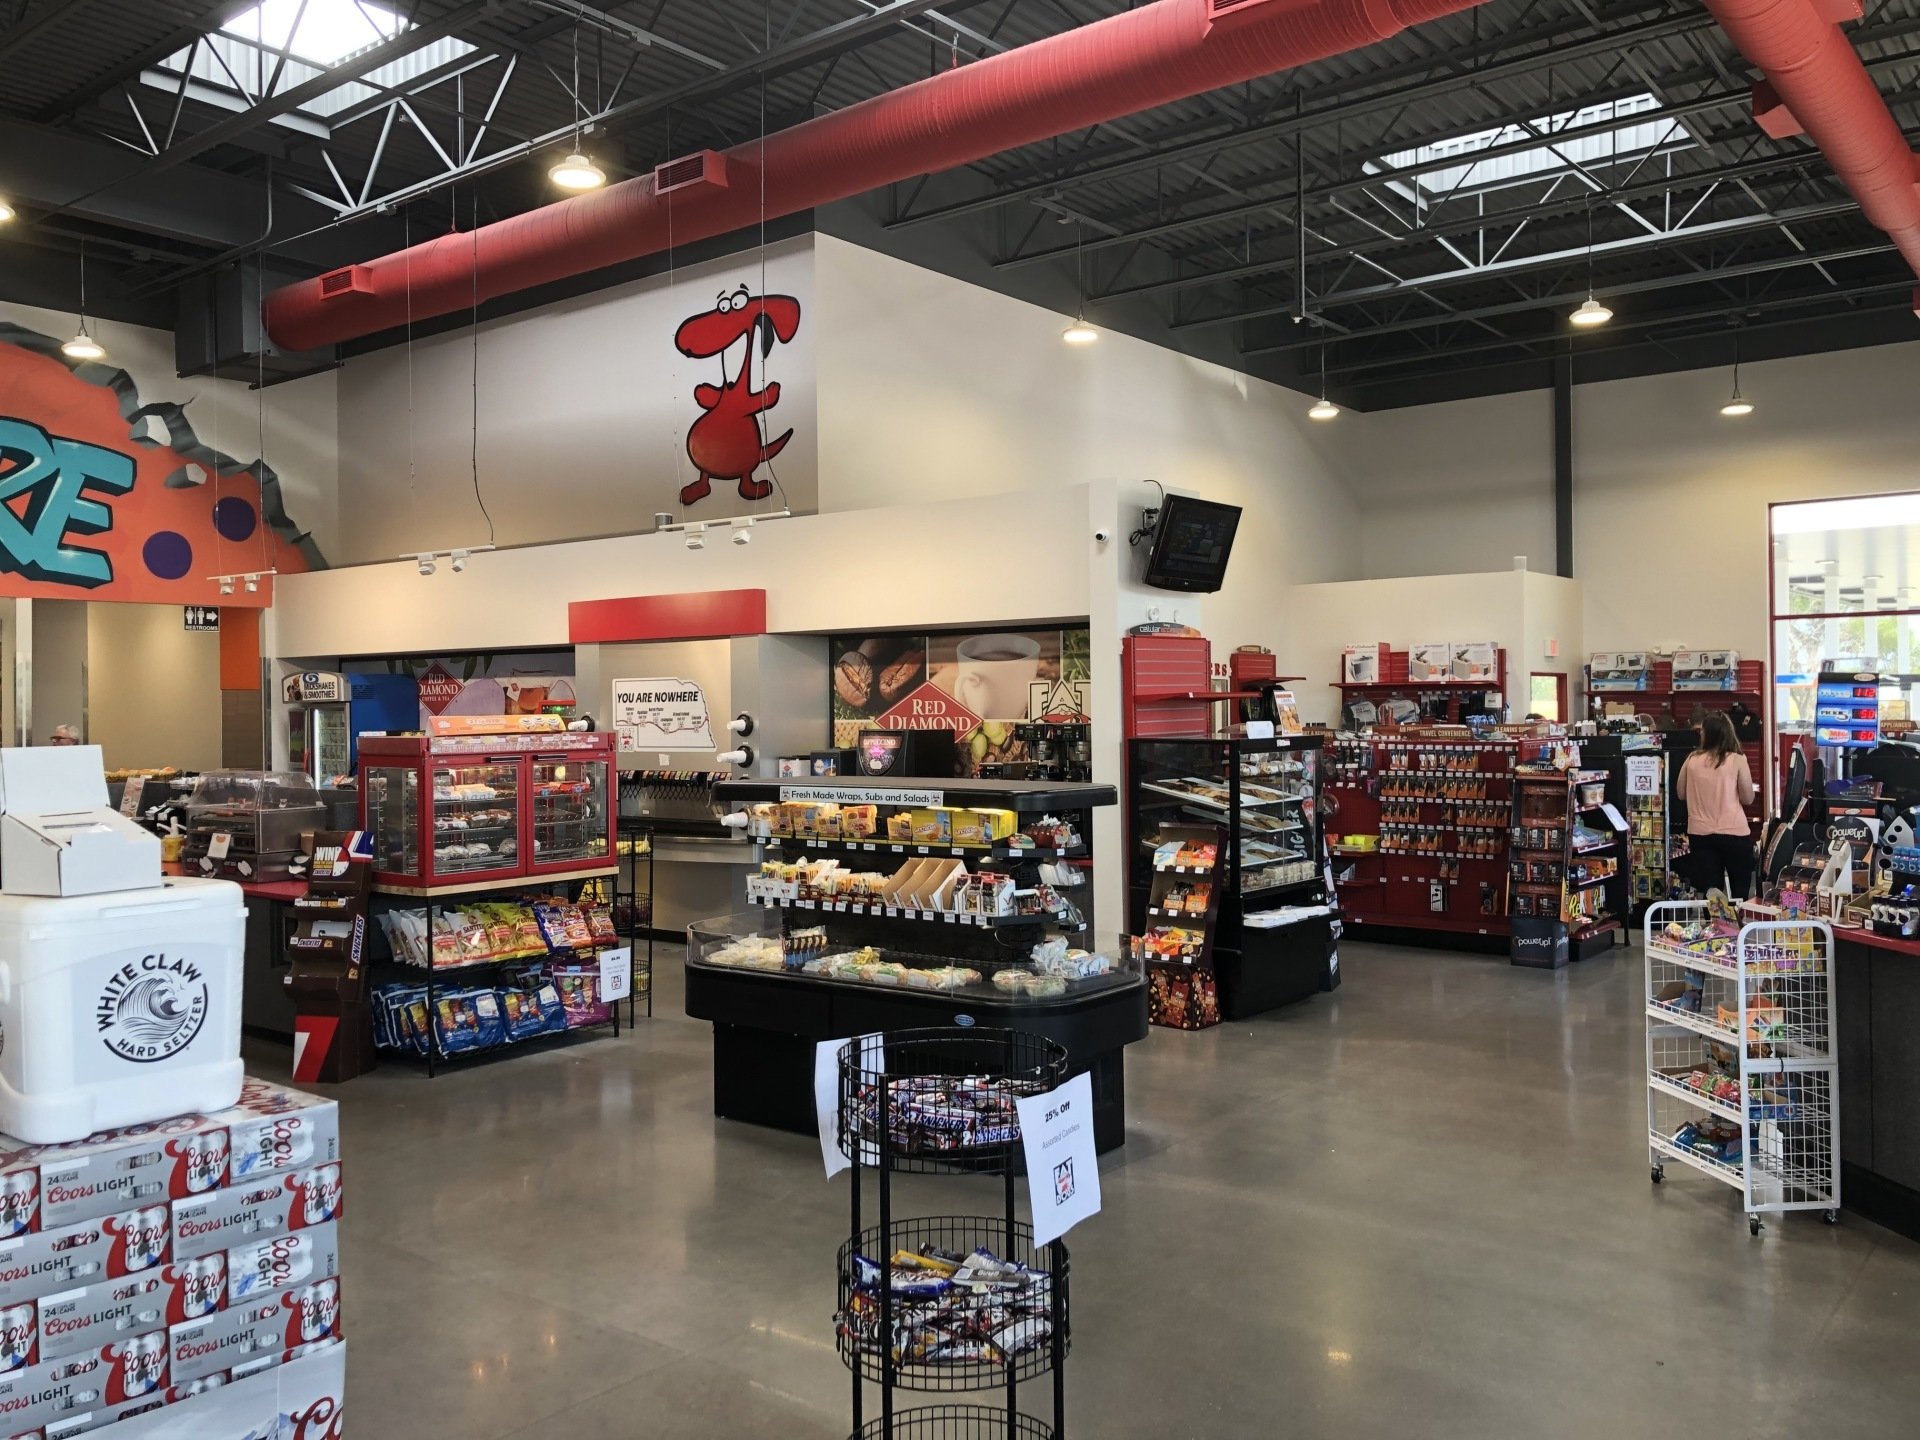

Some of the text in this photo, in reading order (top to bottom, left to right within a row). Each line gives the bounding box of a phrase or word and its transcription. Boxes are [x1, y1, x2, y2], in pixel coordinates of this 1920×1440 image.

[1140, 625, 1160, 633] cellular
[304, 681, 335, 690] MILKSHAKES
[428, 673, 445, 685] RED
[617, 691, 699, 703] YOU ARE NOWHERE
[912, 699, 946, 715] RED
[889, 715, 971, 731] DIAMOND
[1439, 730, 1471, 738] CONVENIENCE
[791, 790, 810, 799] Fresh
[813, 791, 834, 800] Made
[836, 792, 862, 802] Wraps,
[865, 793, 883, 801] Subs
[885, 793, 900, 802] and
[903, 794, 930, 803] Salads
[352, 918, 365, 962] SNICKERS
[97, 953, 202, 1033] WHITE CLAW
[116, 996, 203, 1057] HARD SELTZER
[918, 1115, 969, 1131] SNICKERS
[1044, 1101, 1070, 1123] 25% Off
[974, 1126, 1020, 1142] SNICKERS
[1042, 1123, 1080, 1150] Assorted Candies
[259, 1125, 272, 1168] LIGHT
[47, 1176, 60, 1185] 24
[47, 1175, 135, 1204] Coors LIGHT
[0, 1190, 32, 1212] oors
[178, 1211, 190, 1220] 24
[179, 1209, 258, 1239] Coors LIGHT
[0, 1255, 72, 1282] oors LIGHT
[257, 1245, 271, 1288] LIGHT
[44, 1308, 57, 1318] 24
[44, 1304, 132, 1337] Coors LIGHT
[0, 1324, 30, 1346] oors
[175, 1334, 187, 1344] 24
[175, 1328, 255, 1362] Coors LIGHT
[0, 1384, 71, 1413] oors LIGHT
